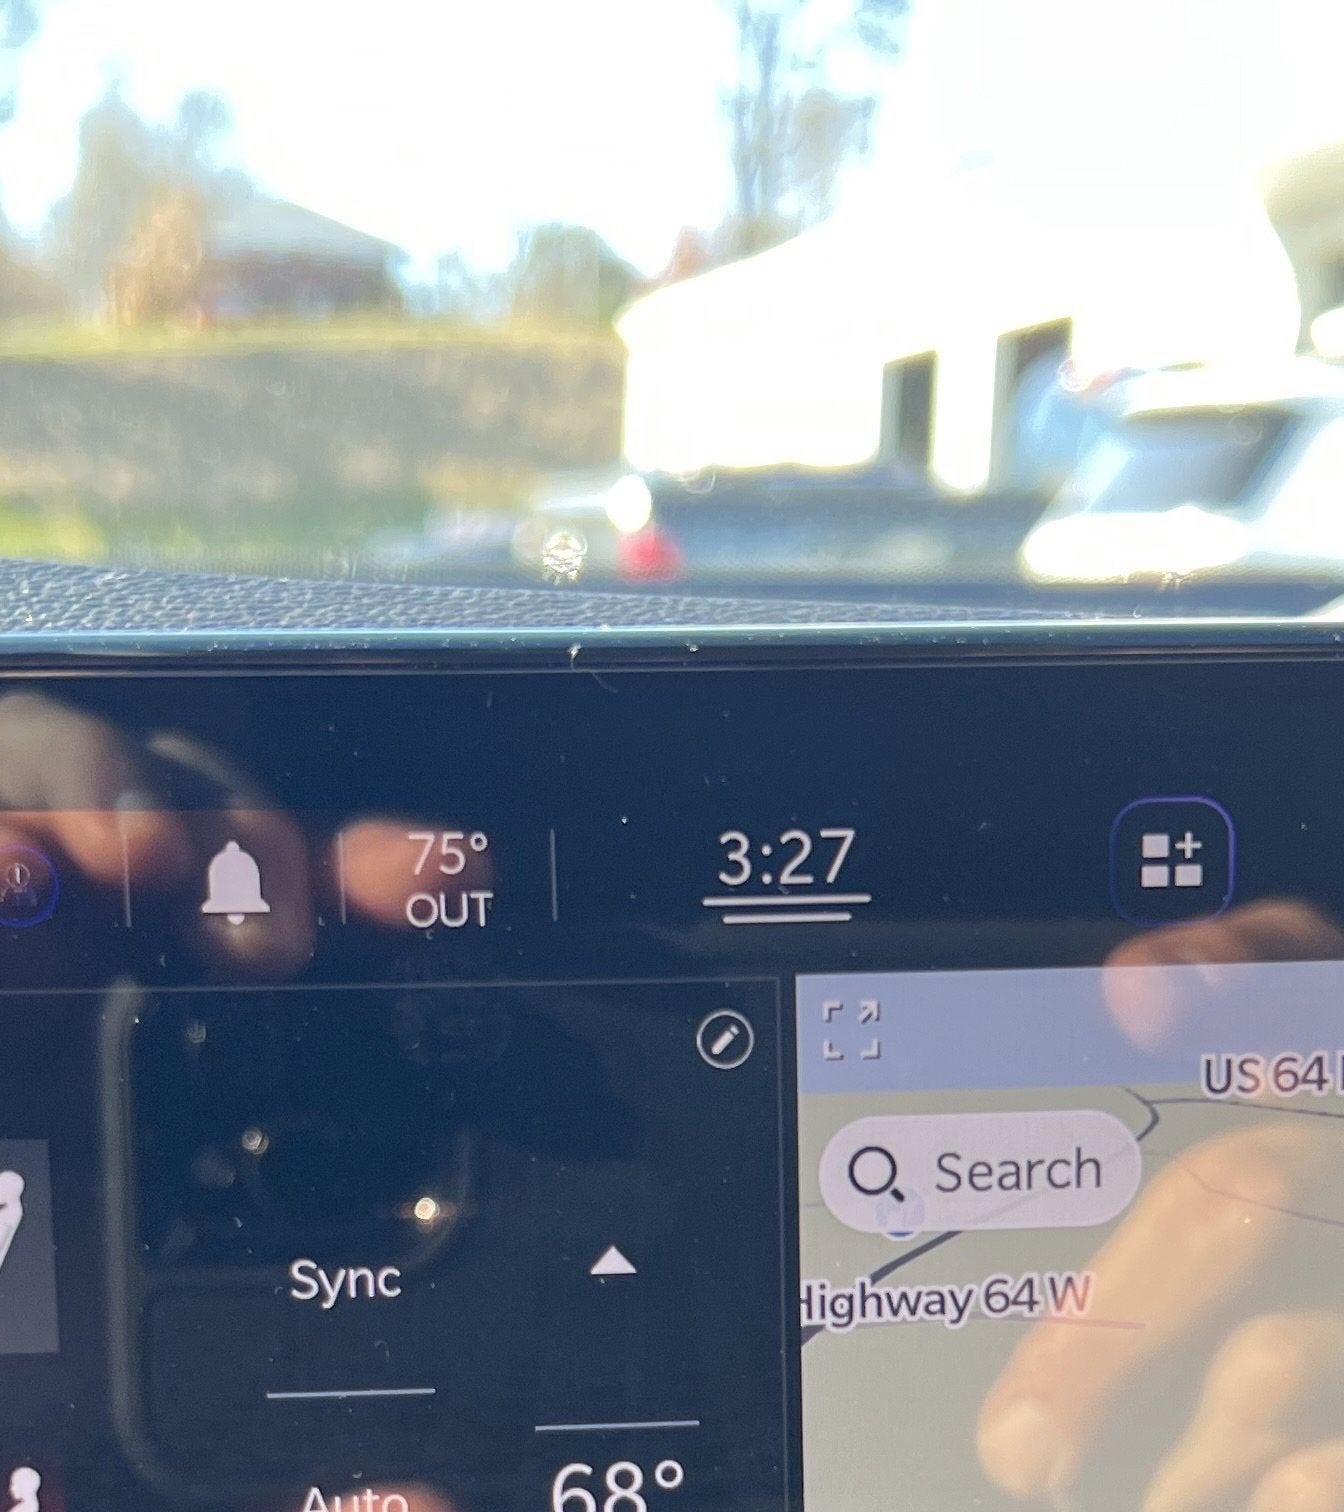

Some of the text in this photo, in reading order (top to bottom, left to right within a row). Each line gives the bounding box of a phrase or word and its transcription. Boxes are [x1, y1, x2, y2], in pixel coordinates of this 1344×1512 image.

[718, 828, 856, 886] 3:27
[406, 891, 493, 929] OUT
[1203, 1058, 1260, 1095] US
[1272, 1055, 1328, 1093] 64
[935, 1148, 1101, 1192] Search
[290, 1260, 401, 1308] Sync
[984, 1278, 1039, 1314] 64
[1048, 1275, 1091, 1313] W
